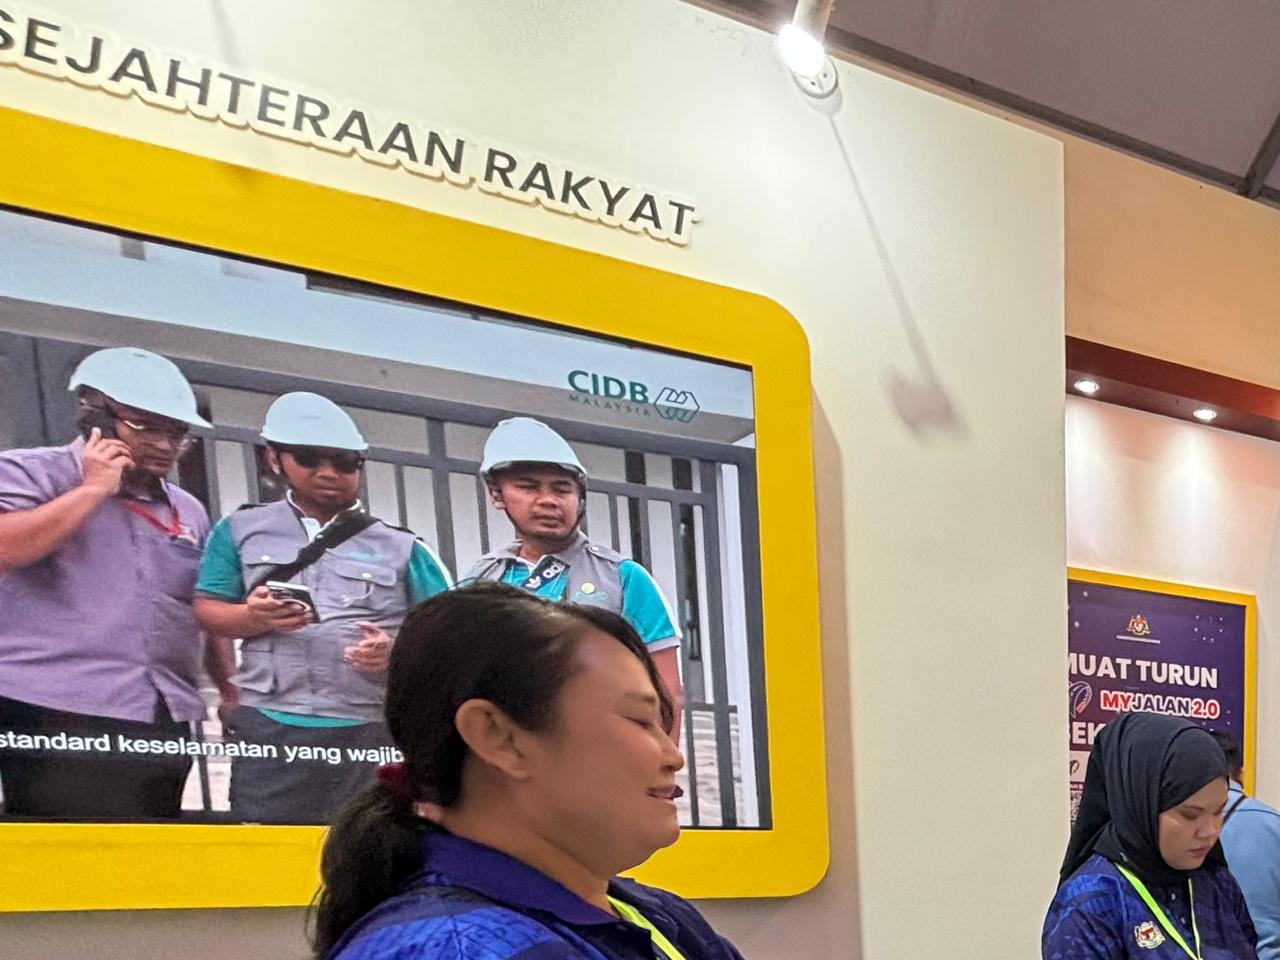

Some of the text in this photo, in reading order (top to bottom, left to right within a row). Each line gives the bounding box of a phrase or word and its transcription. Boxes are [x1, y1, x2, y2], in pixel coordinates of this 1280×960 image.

[484, 148, 697, 237] RAKYAT
[568, 369, 649, 404] CIDB
[568, 394, 650, 416] MALAYSIA
[1136, 659, 1218, 689] TURUN
[118, 735, 278, 759] keselamatan
[284, 745, 341, 765] yang
[347, 746, 404, 765] wajib
